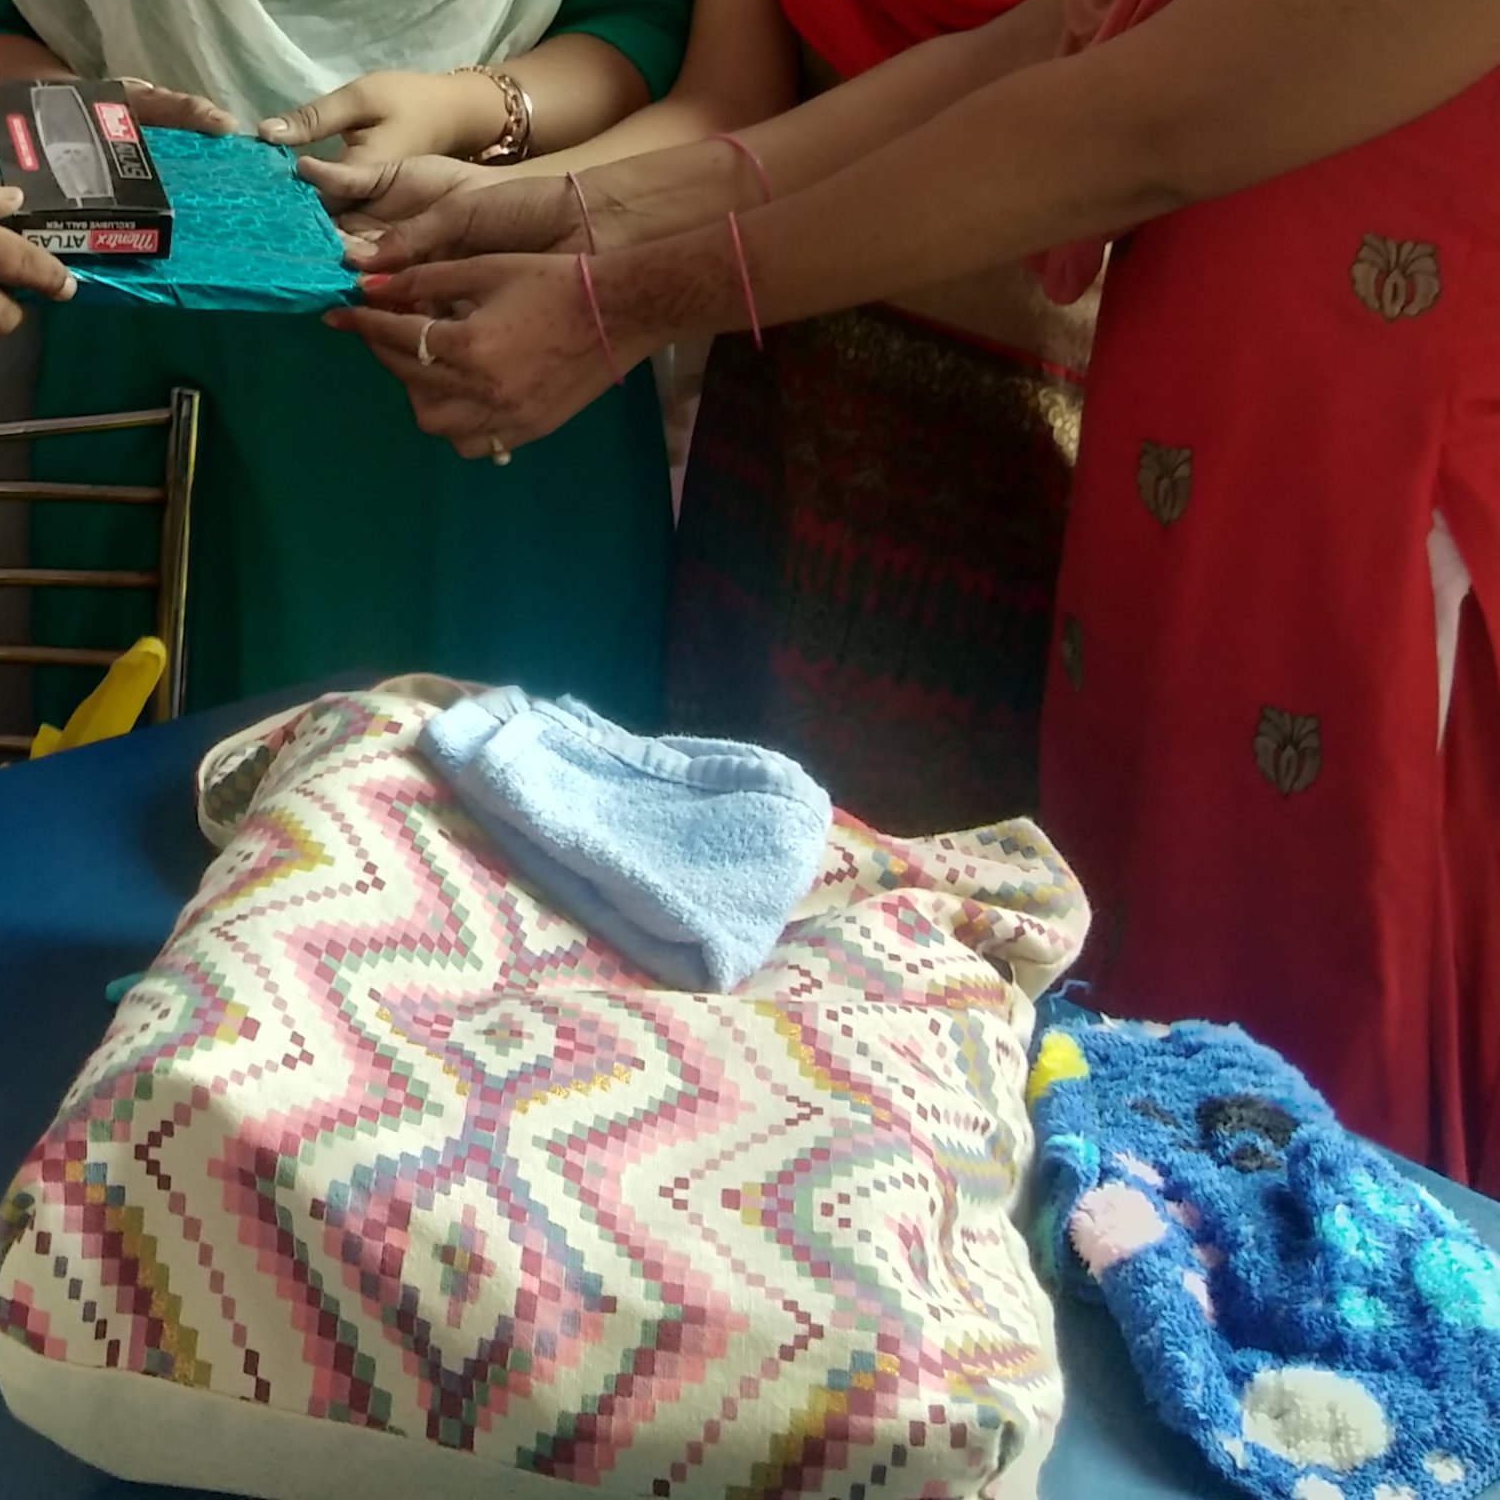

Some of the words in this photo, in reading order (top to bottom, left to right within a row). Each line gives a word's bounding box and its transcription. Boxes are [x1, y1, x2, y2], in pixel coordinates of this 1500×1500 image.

[46, 220, 65, 229] PEN
[65, 220, 88, 229] BALL
[89, 220, 136, 229] EXCLUSIVE
[27, 233, 86, 249] ATLAS
[96, 231, 155, 250] Montex
